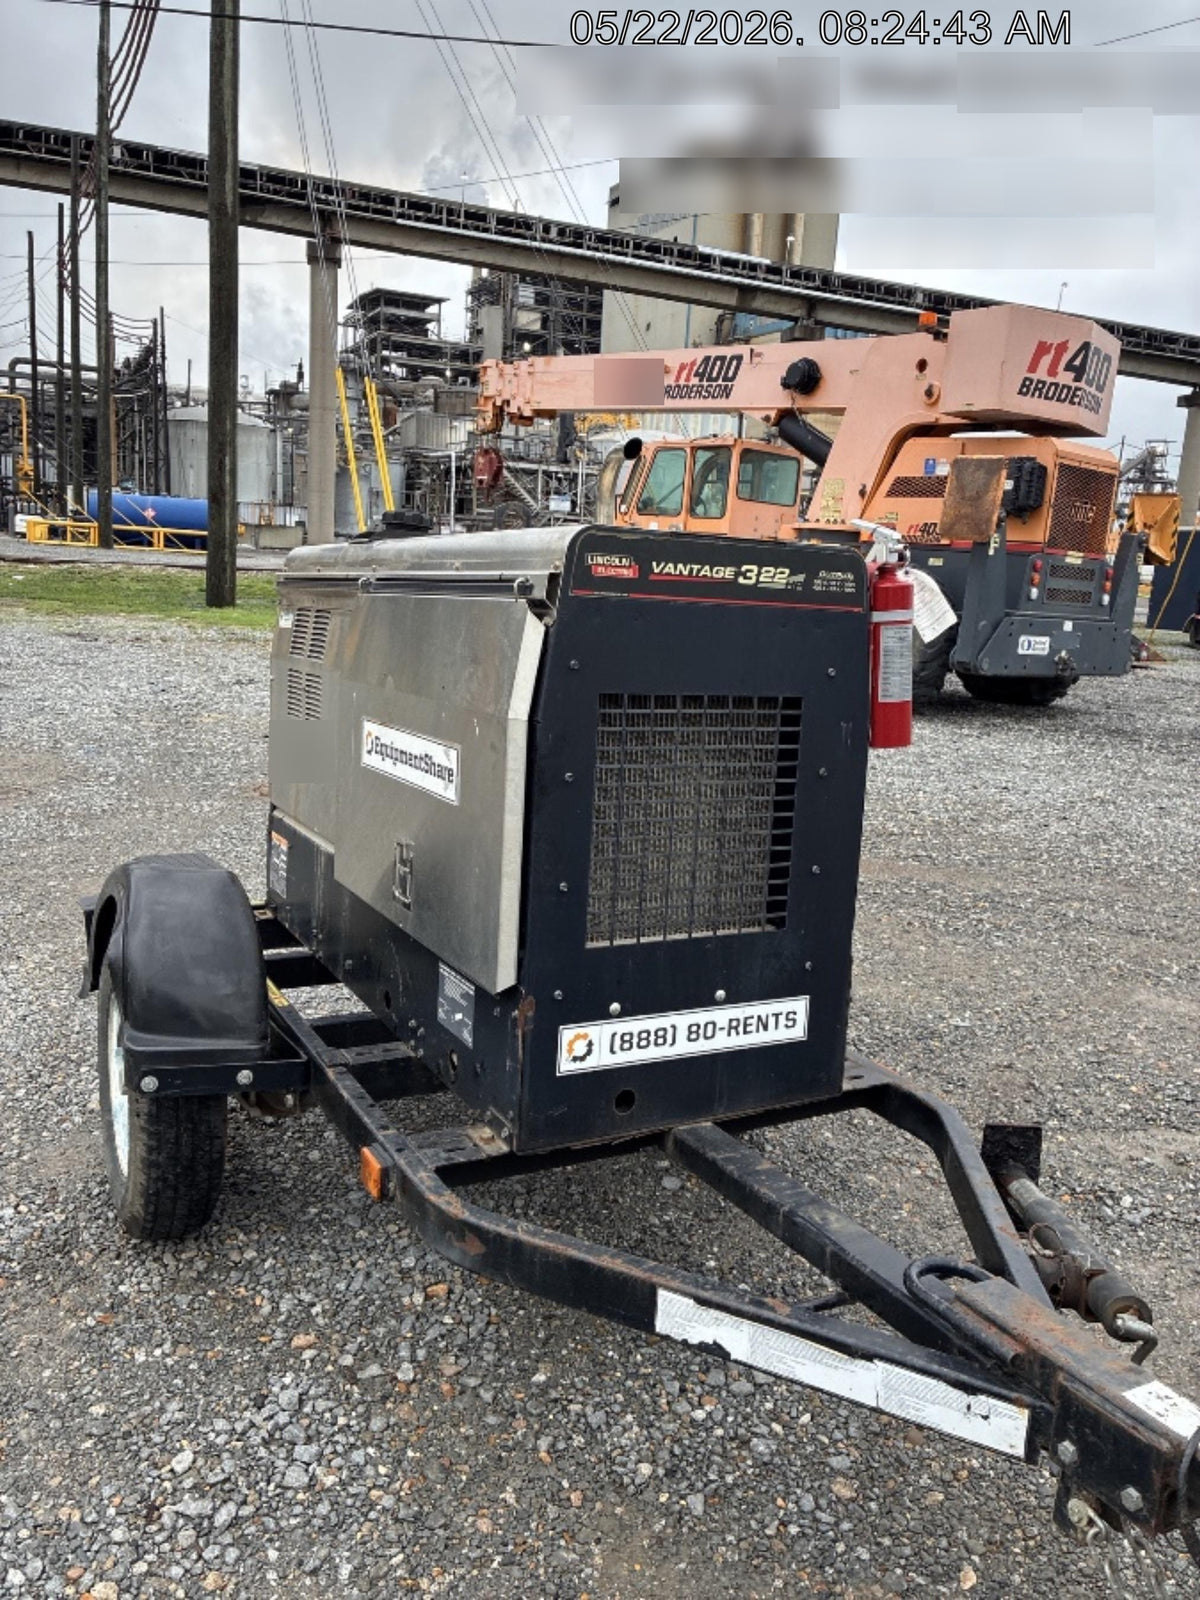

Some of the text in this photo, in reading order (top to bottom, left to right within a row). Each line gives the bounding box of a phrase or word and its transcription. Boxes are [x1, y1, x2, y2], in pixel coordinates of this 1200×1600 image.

[674, 354, 743, 383] rt400
[1026, 339, 1112, 393] rt400
[664, 383, 734, 399] RODERSON
[1017, 377, 1102, 415] BRODERSON
[588, 555, 630, 566] LINCOLN
[652, 561, 790, 584] VANTAGE 322
[375, 736, 454, 783] EquipmentShare
[609, 1011, 798, 1055] (888) 80-RENTS
